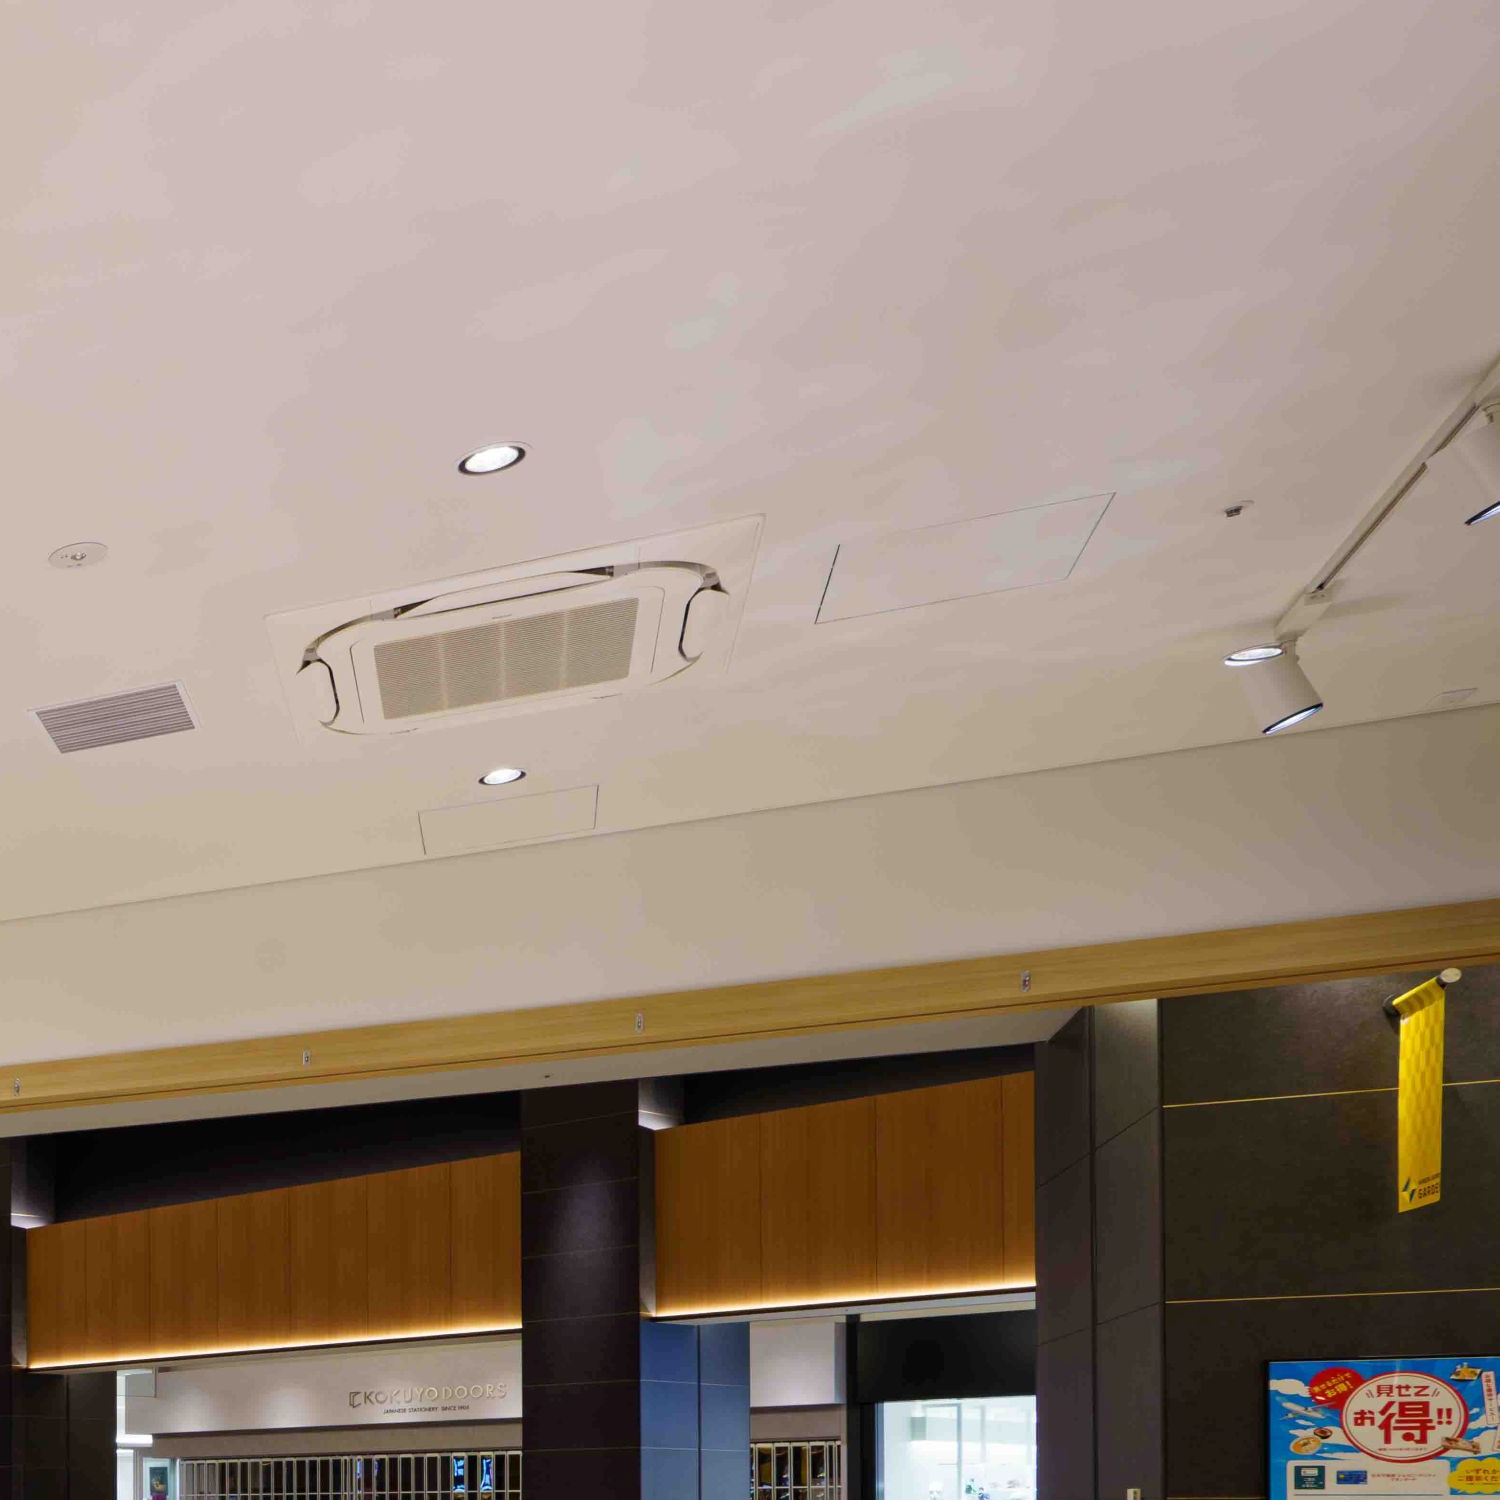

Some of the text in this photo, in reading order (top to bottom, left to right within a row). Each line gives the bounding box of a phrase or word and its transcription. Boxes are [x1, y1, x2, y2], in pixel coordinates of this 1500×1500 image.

[364, 1383, 507, 1405] KOKUYO DOORS
[1376, 1384, 1431, 1398] 見せて
